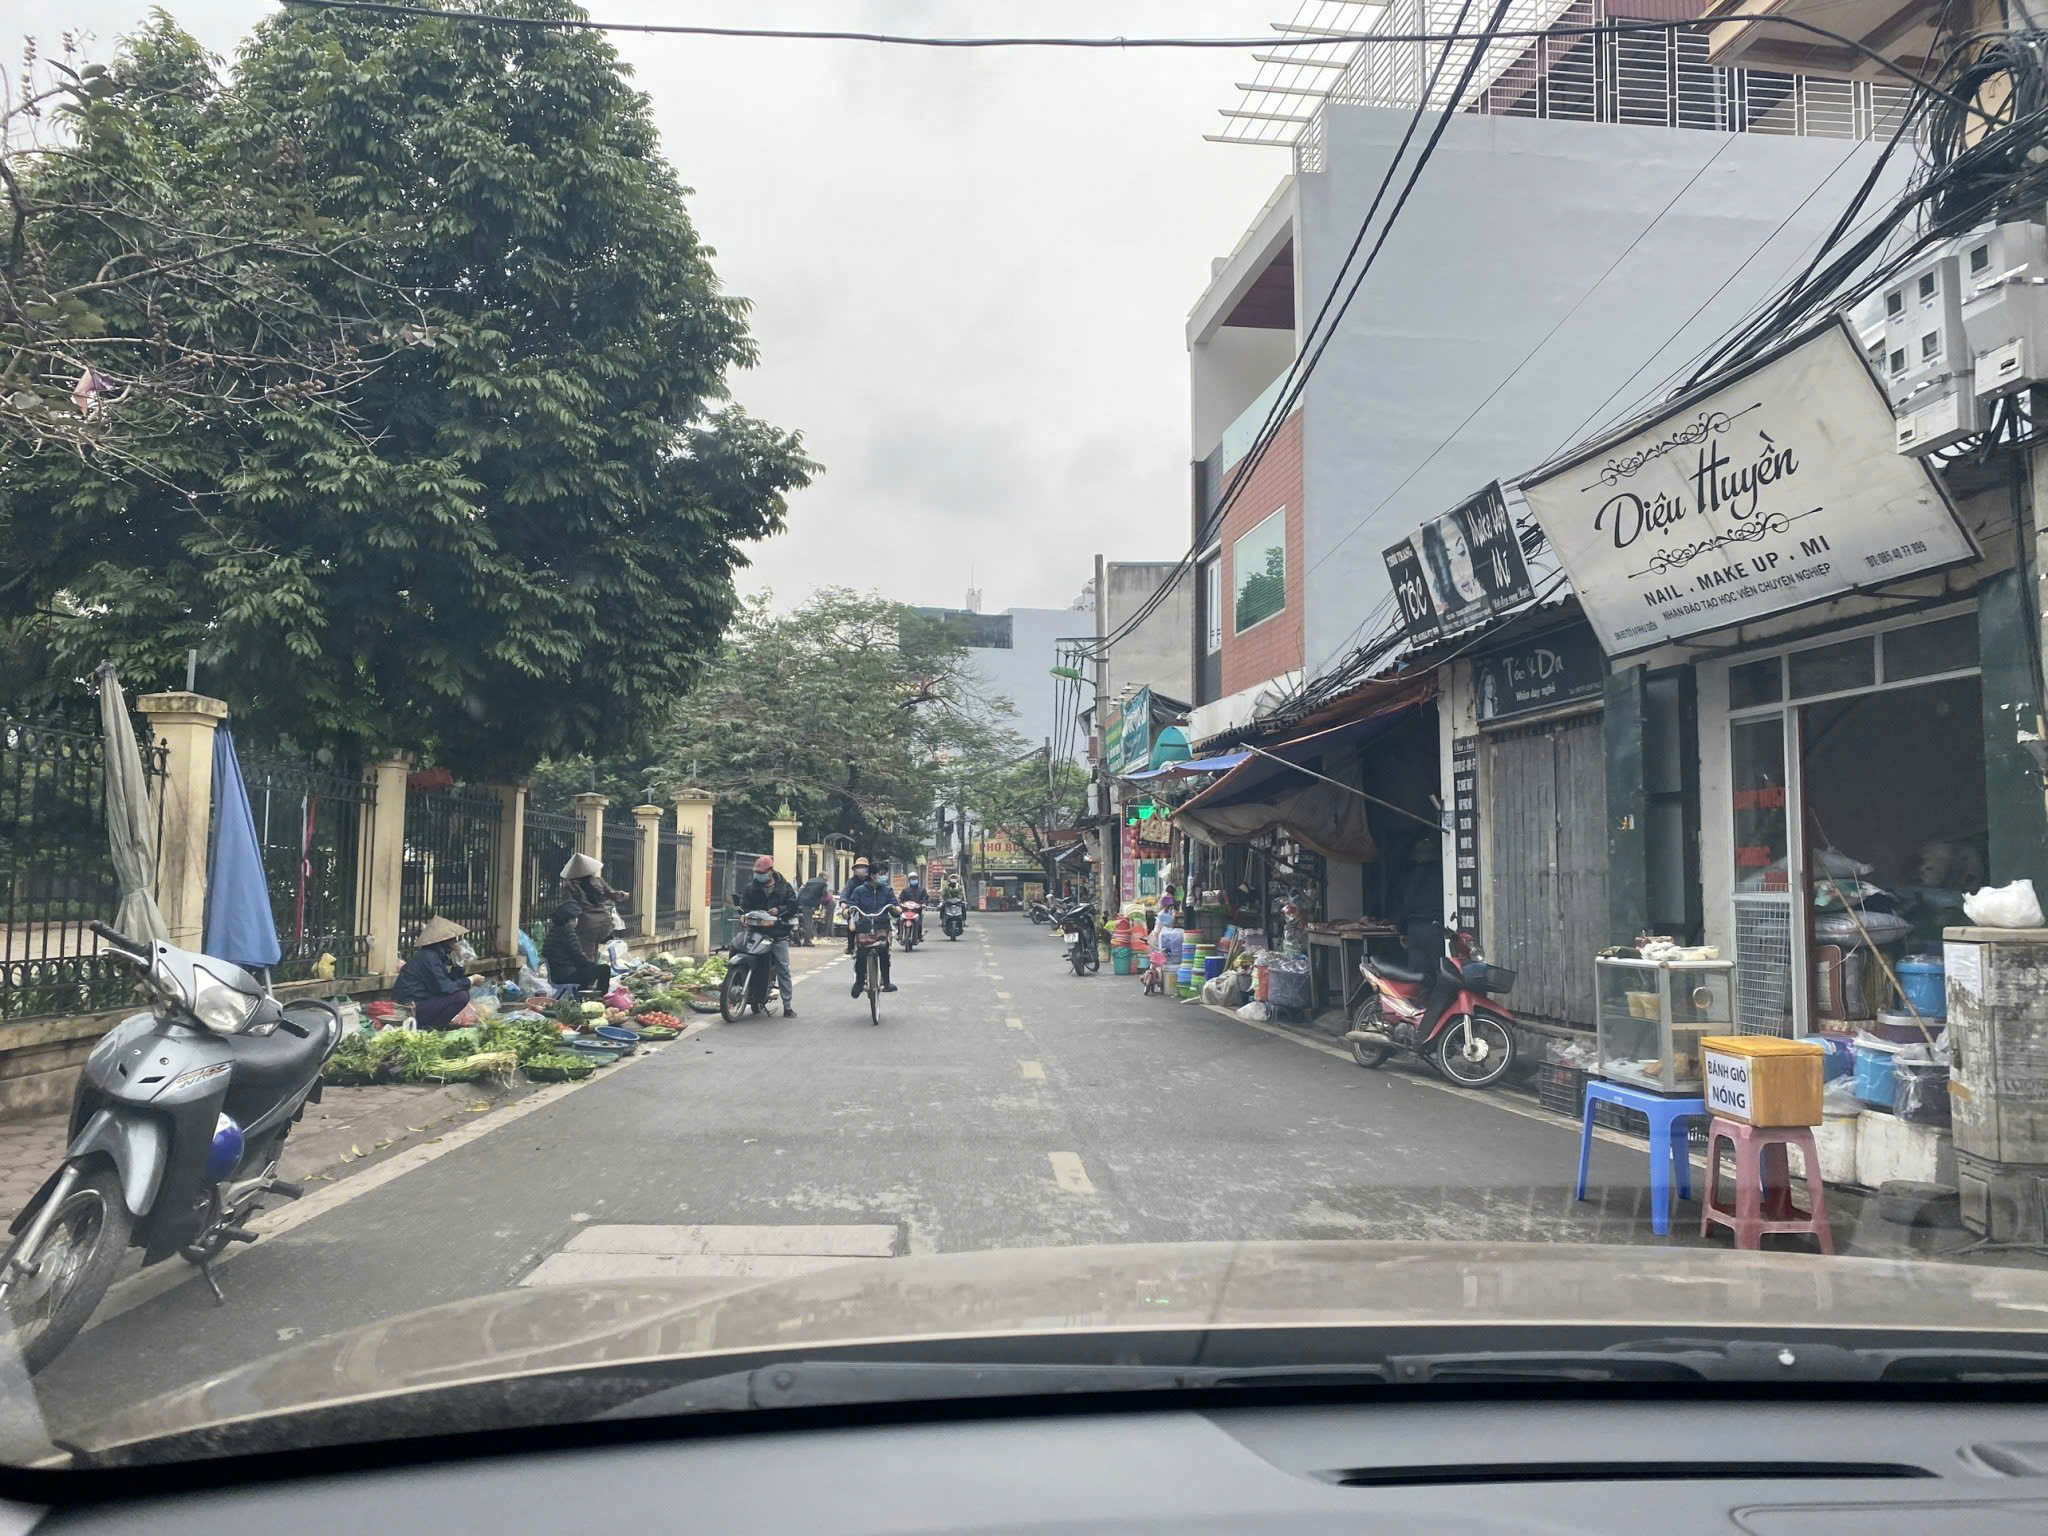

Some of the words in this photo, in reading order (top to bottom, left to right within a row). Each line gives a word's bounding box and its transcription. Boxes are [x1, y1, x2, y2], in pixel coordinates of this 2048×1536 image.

[1595, 492, 1686, 549] Diệu
[1689, 430, 1799, 520] Huyền
[1643, 584, 1684, 606] NAIL
[1696, 562, 1749, 591] MAKE
[1752, 551, 1779, 573] UP
[1800, 535, 1831, 557] MI
[1719, 592, 1738, 606] HỌC
[1738, 584, 1758, 599] VIÊN
[1757, 574, 1796, 593] CHUYÊN
[1796, 562, 1832, 581] NGHIỆP
[1503, 656, 1525, 688] Tóc
[1534, 649, 1564, 680] Da
[1708, 1060, 1729, 1079] BÁNH
[1730, 1067, 1746, 1083] GIÒ
[1712, 1085, 1746, 1109] NÓNG
